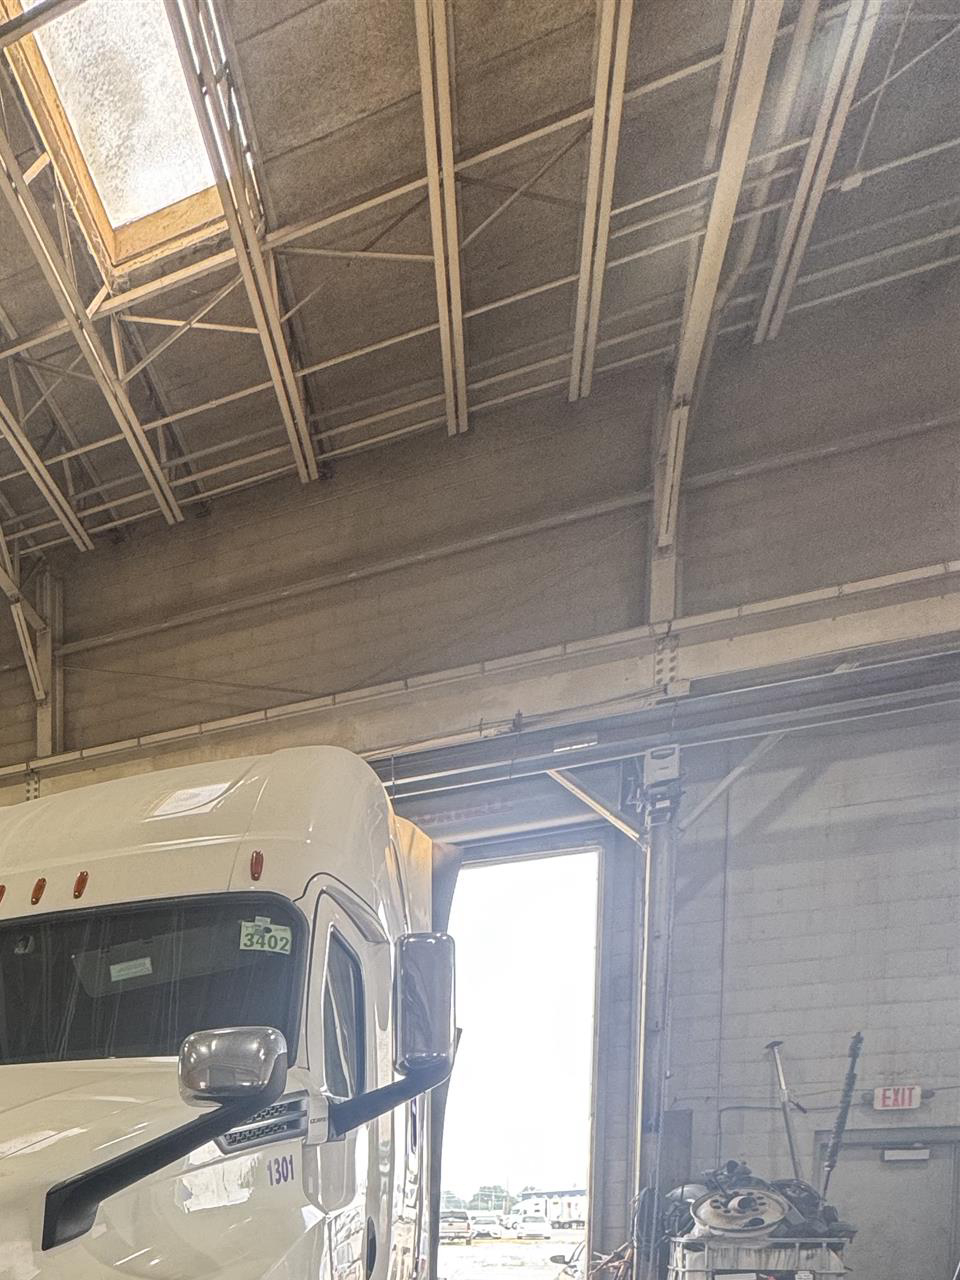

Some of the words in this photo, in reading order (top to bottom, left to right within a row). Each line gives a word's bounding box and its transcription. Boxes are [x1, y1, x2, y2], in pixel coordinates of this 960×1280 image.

[243, 932, 289, 951] 3402
[881, 1087, 915, 1108] EXIT
[267, 1154, 294, 1186] 1301
